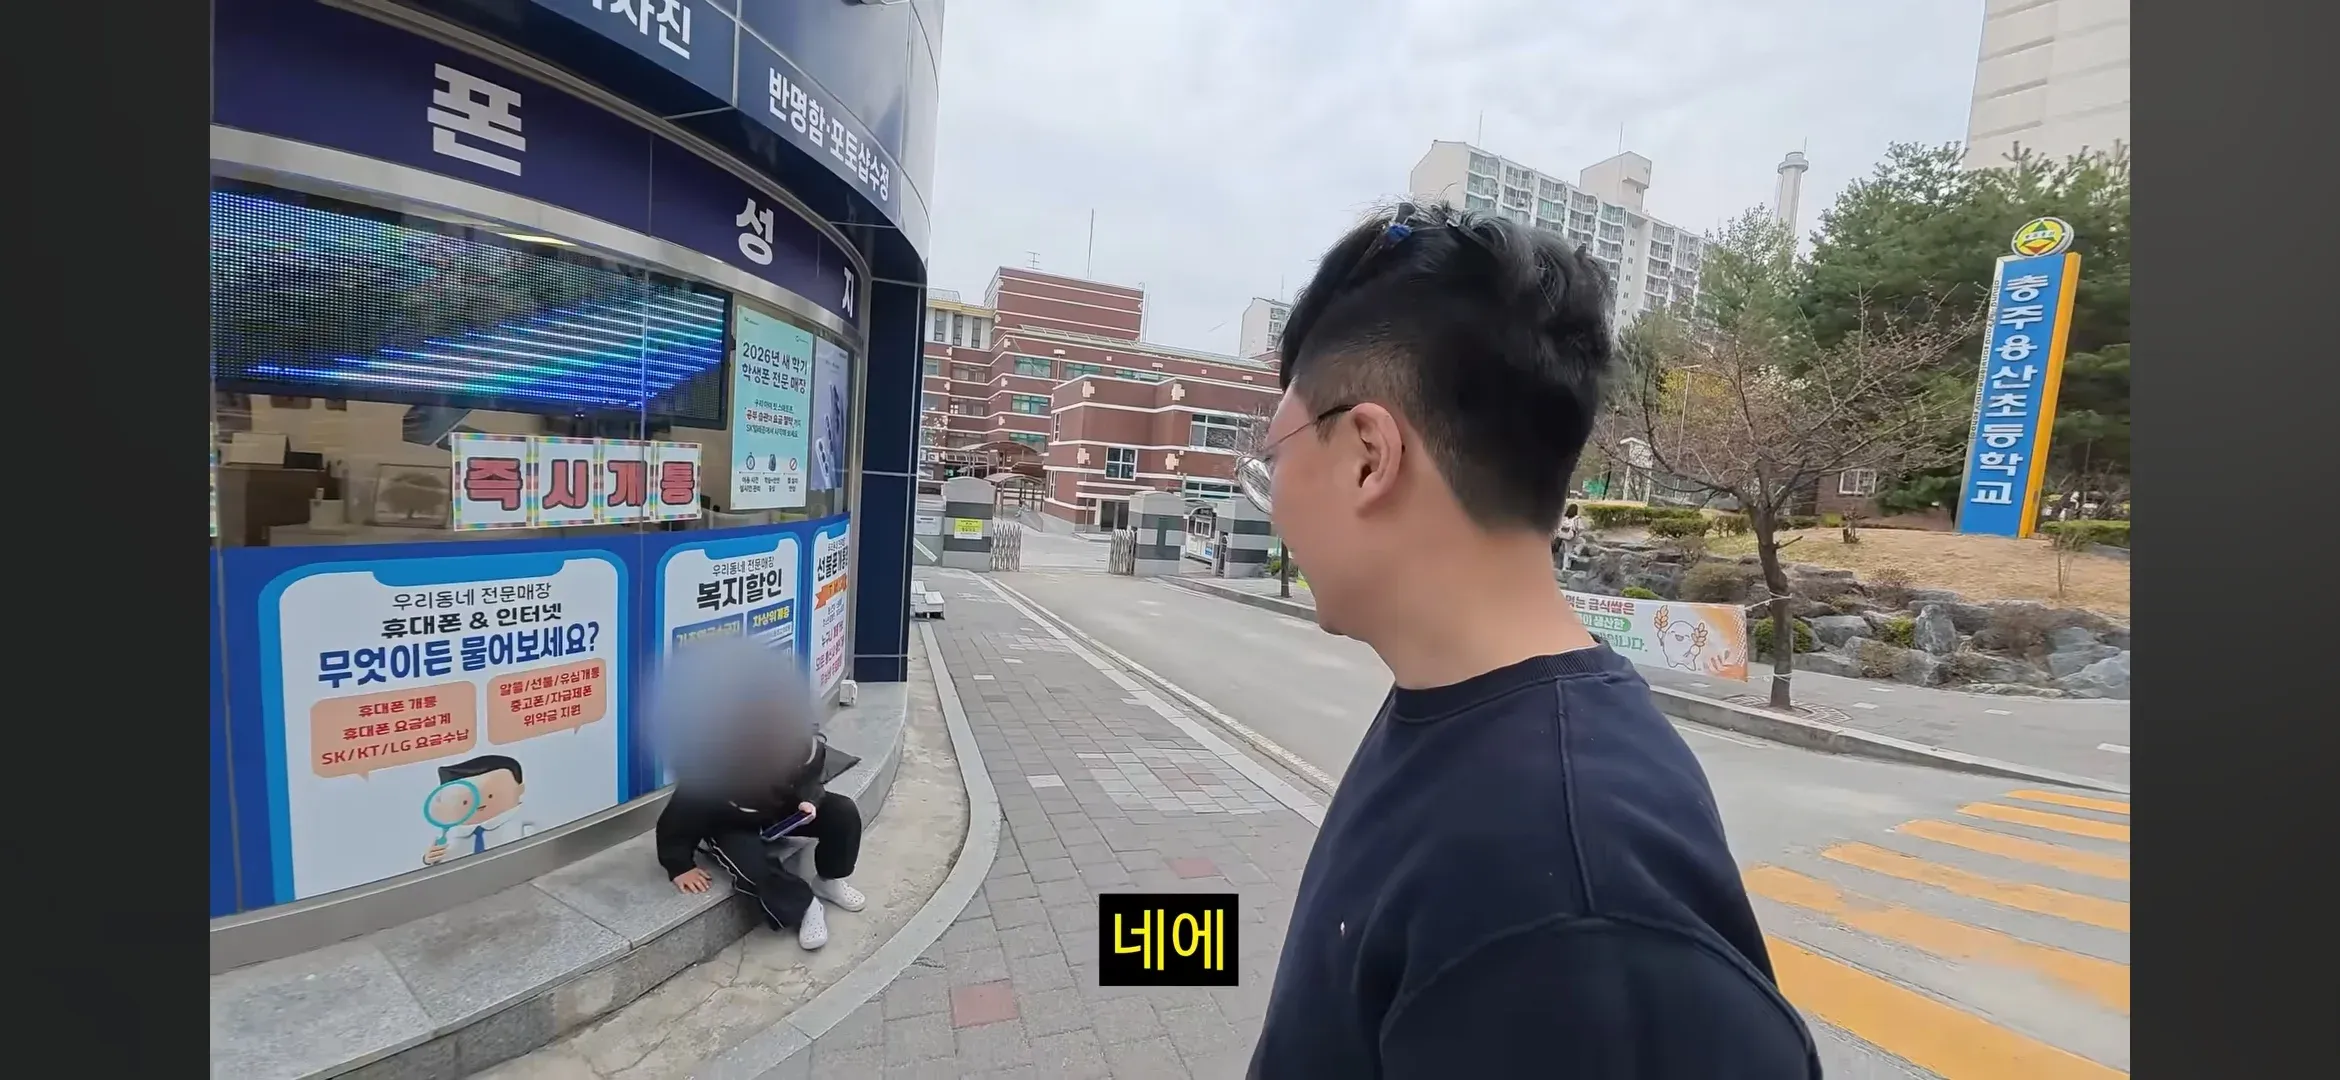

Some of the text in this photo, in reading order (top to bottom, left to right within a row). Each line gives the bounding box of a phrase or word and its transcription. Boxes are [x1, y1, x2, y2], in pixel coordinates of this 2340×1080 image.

[592, 0, 691, 60] 사진
[743, 342, 780, 368] 2026년
[741, 363, 771, 386] 학생폰
[1971, 275, 2049, 505] 충주용산초등학교
[464, 457, 696, 511] 즉시개통
[712, 560, 746, 577] 우리동네
[392, 582, 552, 611] 우리동네 전문매장
[697, 568, 782, 612] 복지할인
[1588, 597, 1636, 616] 급식쌀은
[382, 602, 562, 639] 휴대폰 & 인터넷
[1593, 615, 1626, 631] 생산한
[318, 621, 600, 689] 무엇이든 물어보세요?
[358, 695, 437, 718] 휴대폰 개통
[523, 704, 582, 728] 위약금 지원
[342, 712, 451, 741] 휴대폰 요금설계
[415, 728, 470, 749] 요금수납
